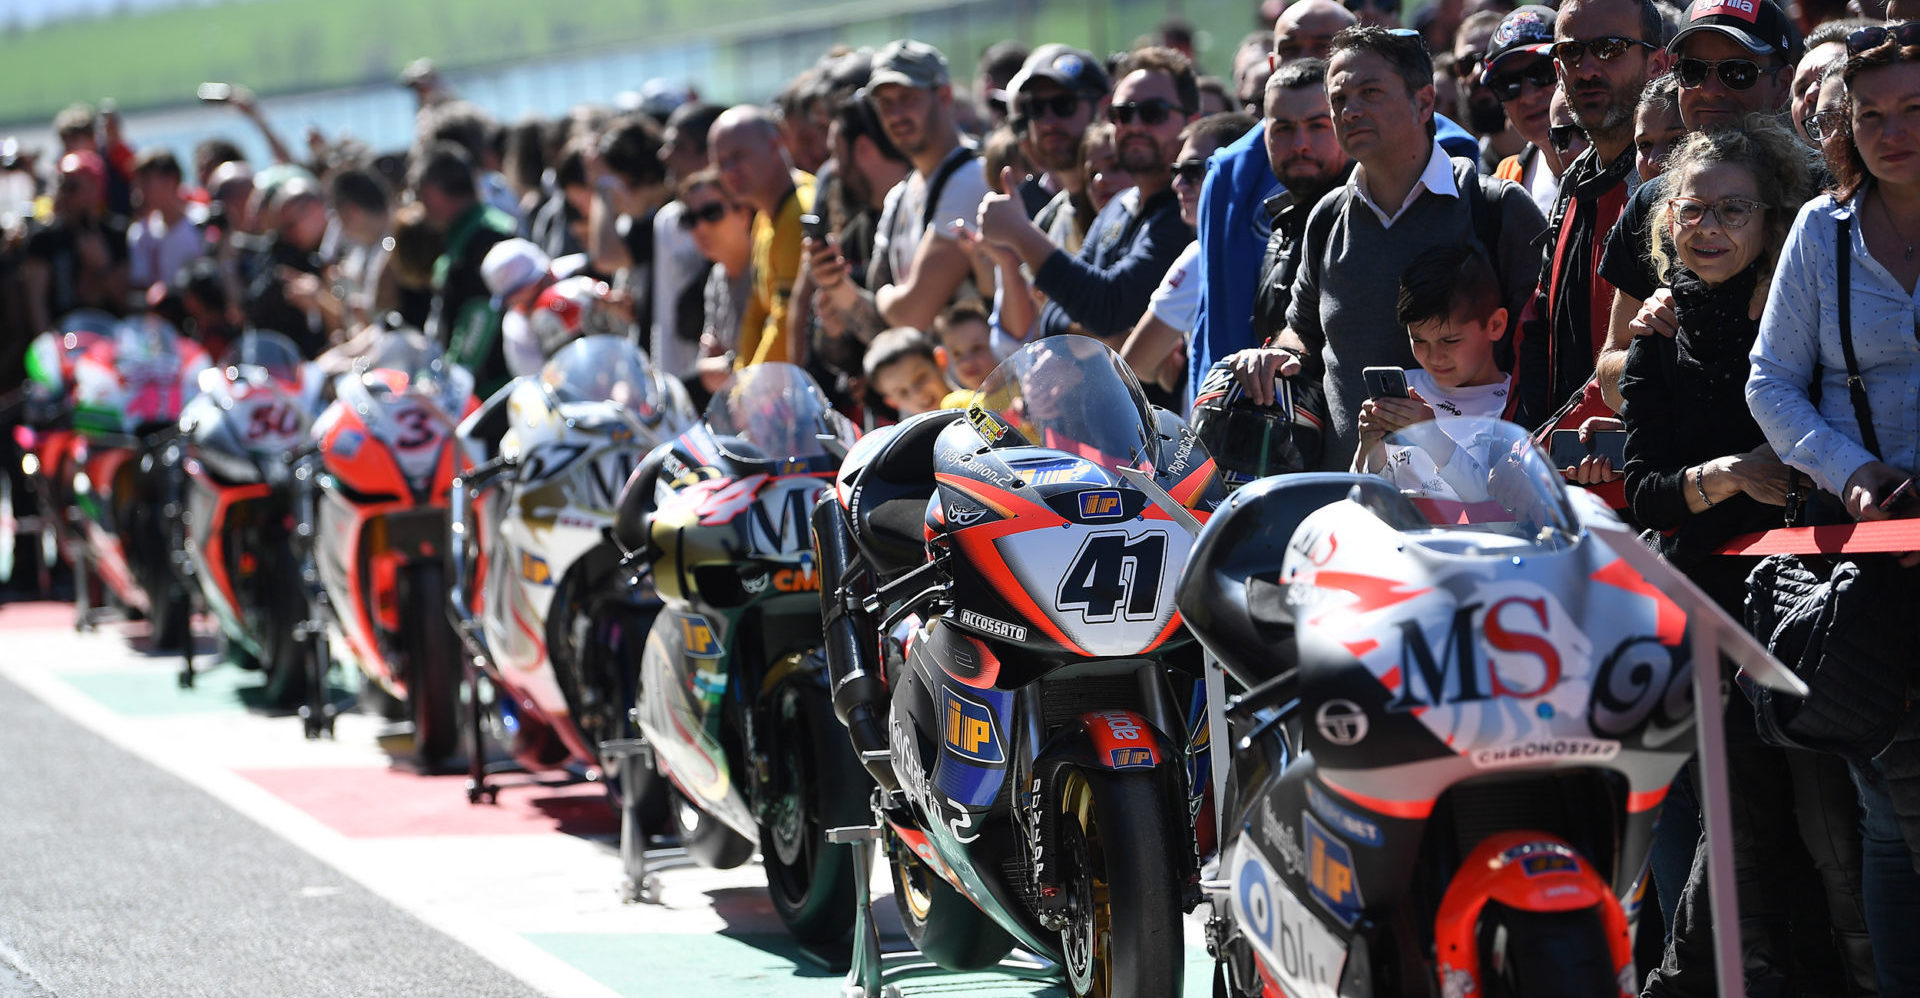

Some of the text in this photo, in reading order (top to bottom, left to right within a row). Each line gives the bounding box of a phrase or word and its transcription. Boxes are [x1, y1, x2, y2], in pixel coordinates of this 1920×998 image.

[397, 407, 434, 451] 3
[969, 406, 987, 425] 41
[1056, 529, 1169, 625] 41
[962, 613, 1025, 640] ACCOSSATO
[1391, 596, 1561, 707] MS
[1032, 778, 1044, 880] DUNLOP
